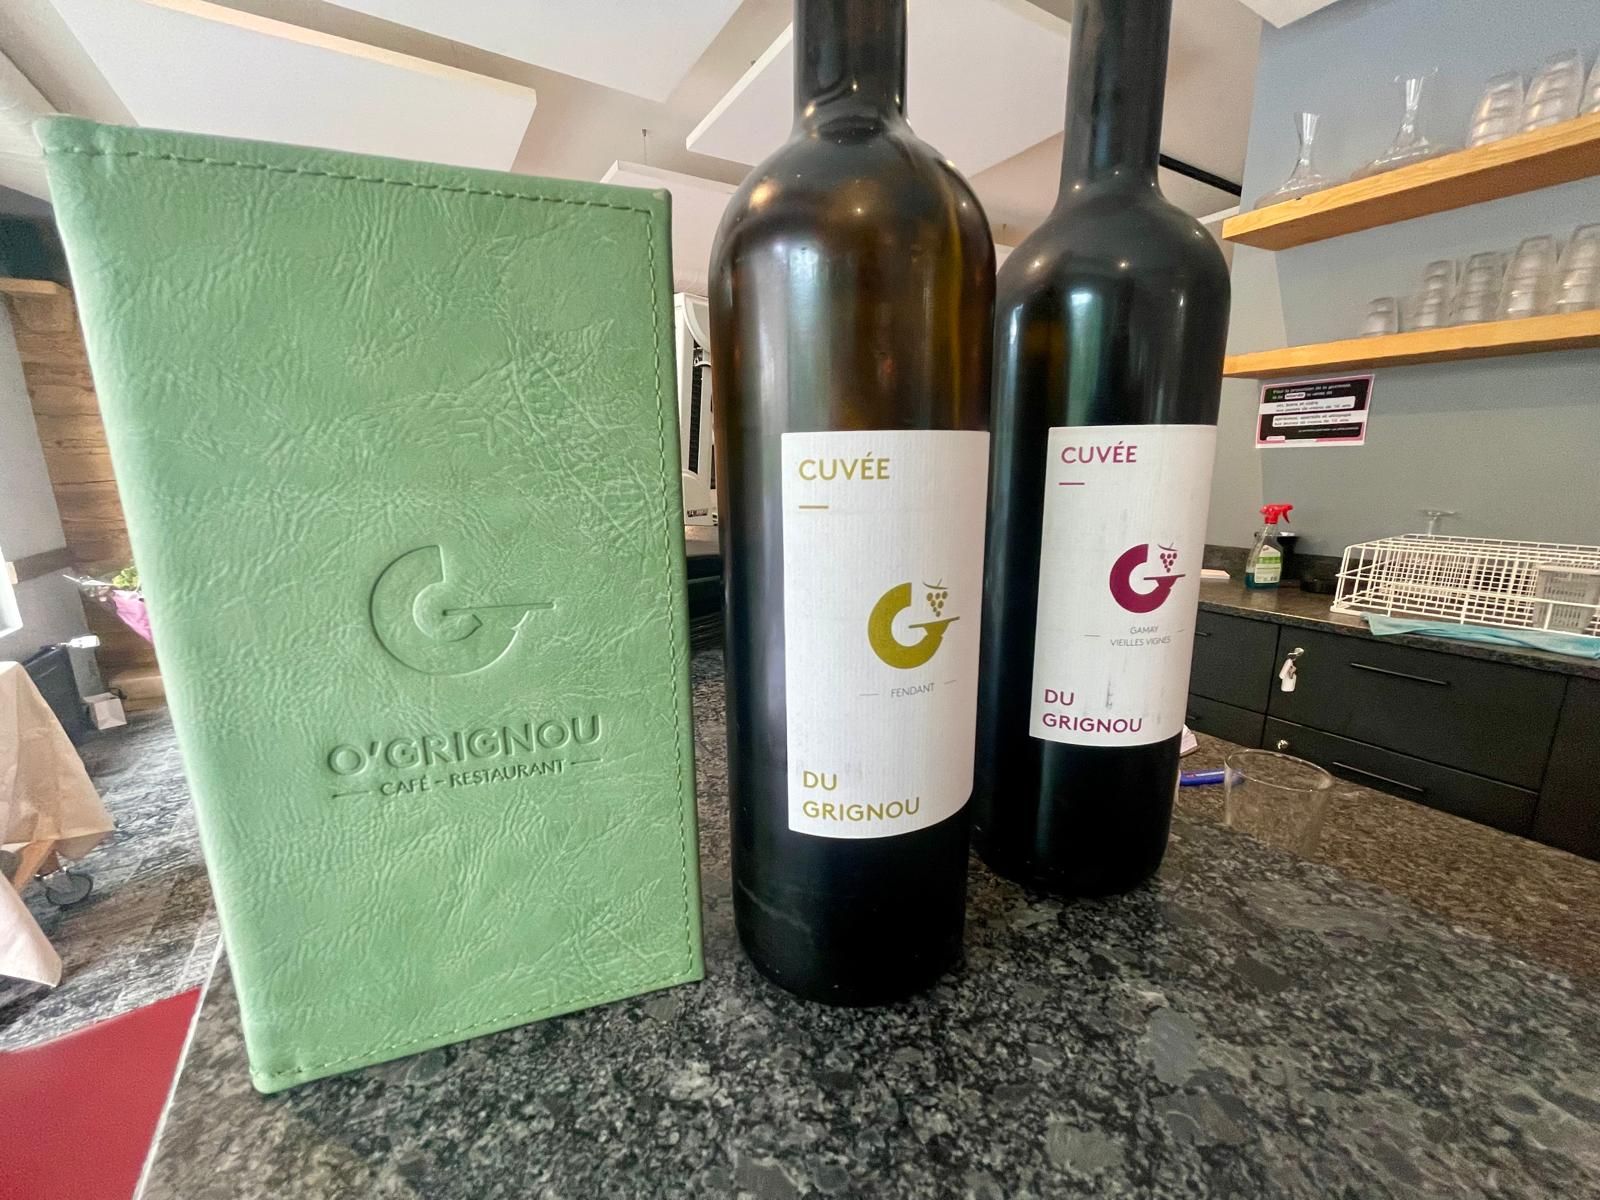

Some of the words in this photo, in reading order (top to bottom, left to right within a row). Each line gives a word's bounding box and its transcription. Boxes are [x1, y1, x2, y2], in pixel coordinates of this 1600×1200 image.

[1061, 441, 1138, 464] CUVÉE
[798, 452, 890, 481] CUVÉE
[1110, 638, 1144, 647] VIEILLES
[1146, 635, 1171, 646] VIGNES
[1129, 625, 1159, 635] GAMAY
[890, 682, 935, 698] FENDANT
[1044, 688, 1074, 707] DU
[1042, 712, 1142, 733] GRIGNOU
[328, 714, 602, 775] O'GRIGNOU
[380, 774, 431, 797] CAFÉ
[449, 758, 566, 789] RESTAURANT
[802, 770, 837, 792] DU
[802, 796, 920, 822] GRIGNOU
